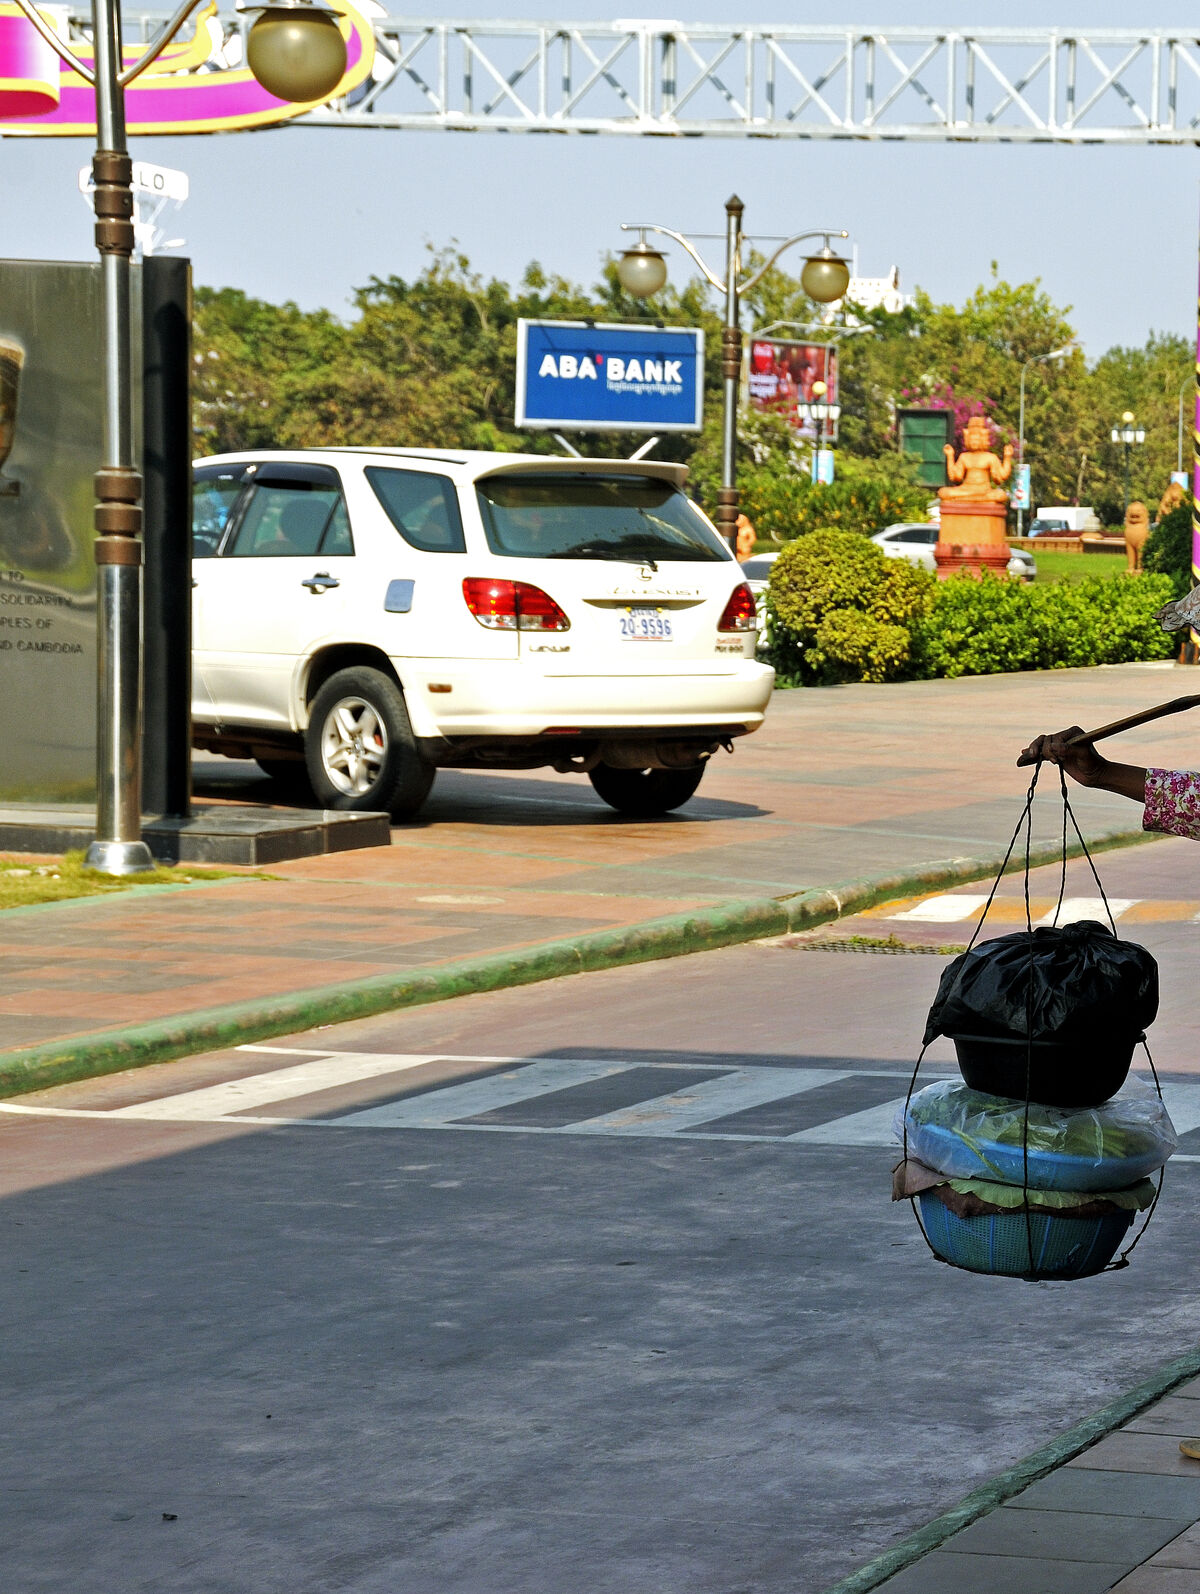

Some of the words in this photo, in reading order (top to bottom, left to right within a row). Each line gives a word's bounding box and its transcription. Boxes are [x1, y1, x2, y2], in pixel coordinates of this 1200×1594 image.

[538, 354, 598, 380] ABA
[606, 357, 682, 384] BANK
[17, 640, 83, 654] CAMBODIA
